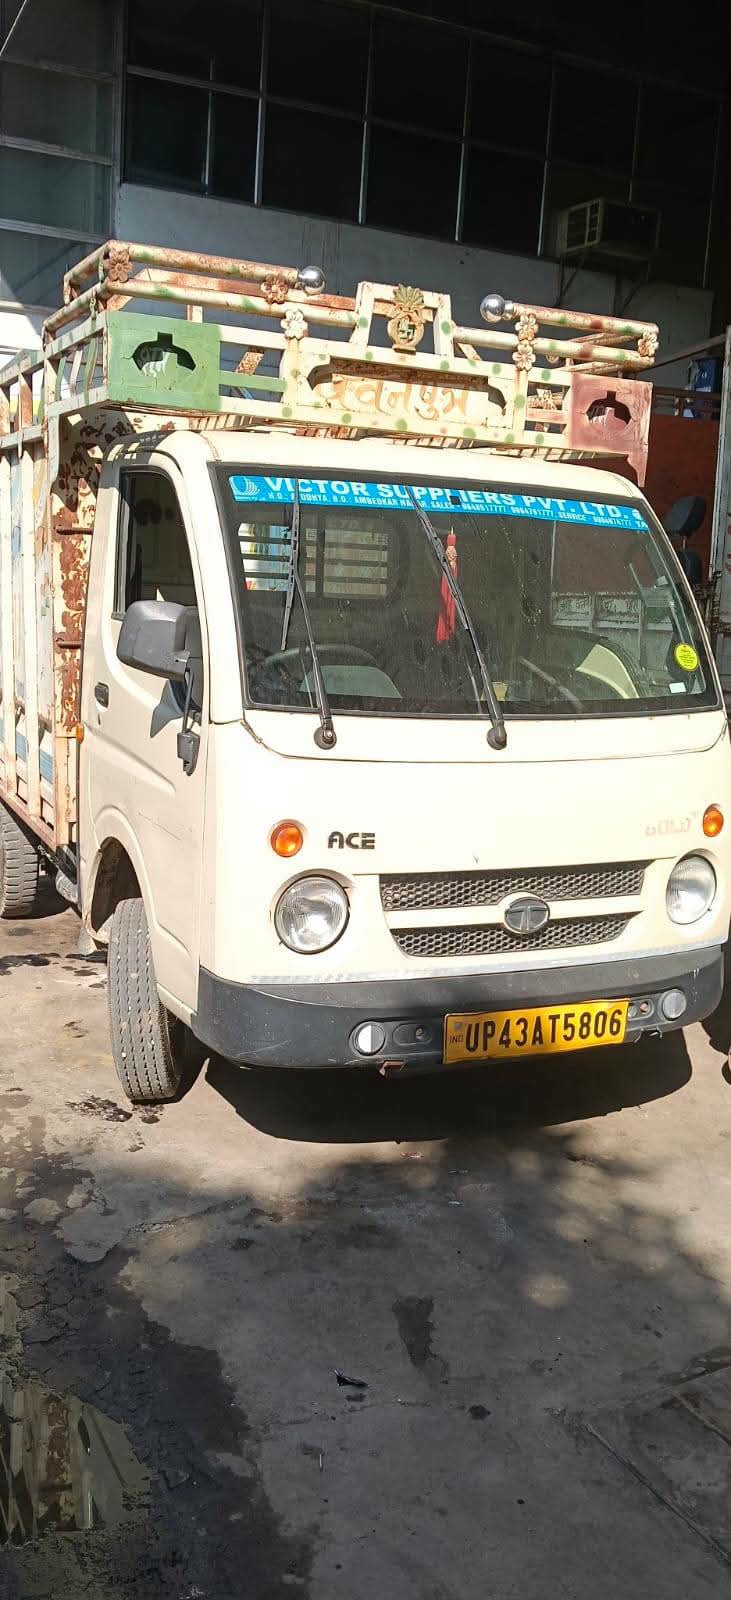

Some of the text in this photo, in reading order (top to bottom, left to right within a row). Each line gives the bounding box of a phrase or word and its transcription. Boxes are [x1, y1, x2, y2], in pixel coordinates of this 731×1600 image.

[264, 477, 629, 519] VICTOR SUPPLIERS PVT. LTD.
[327, 831, 376, 850] ACE
[449, 1009, 623, 1053] IND UP43AT5806
